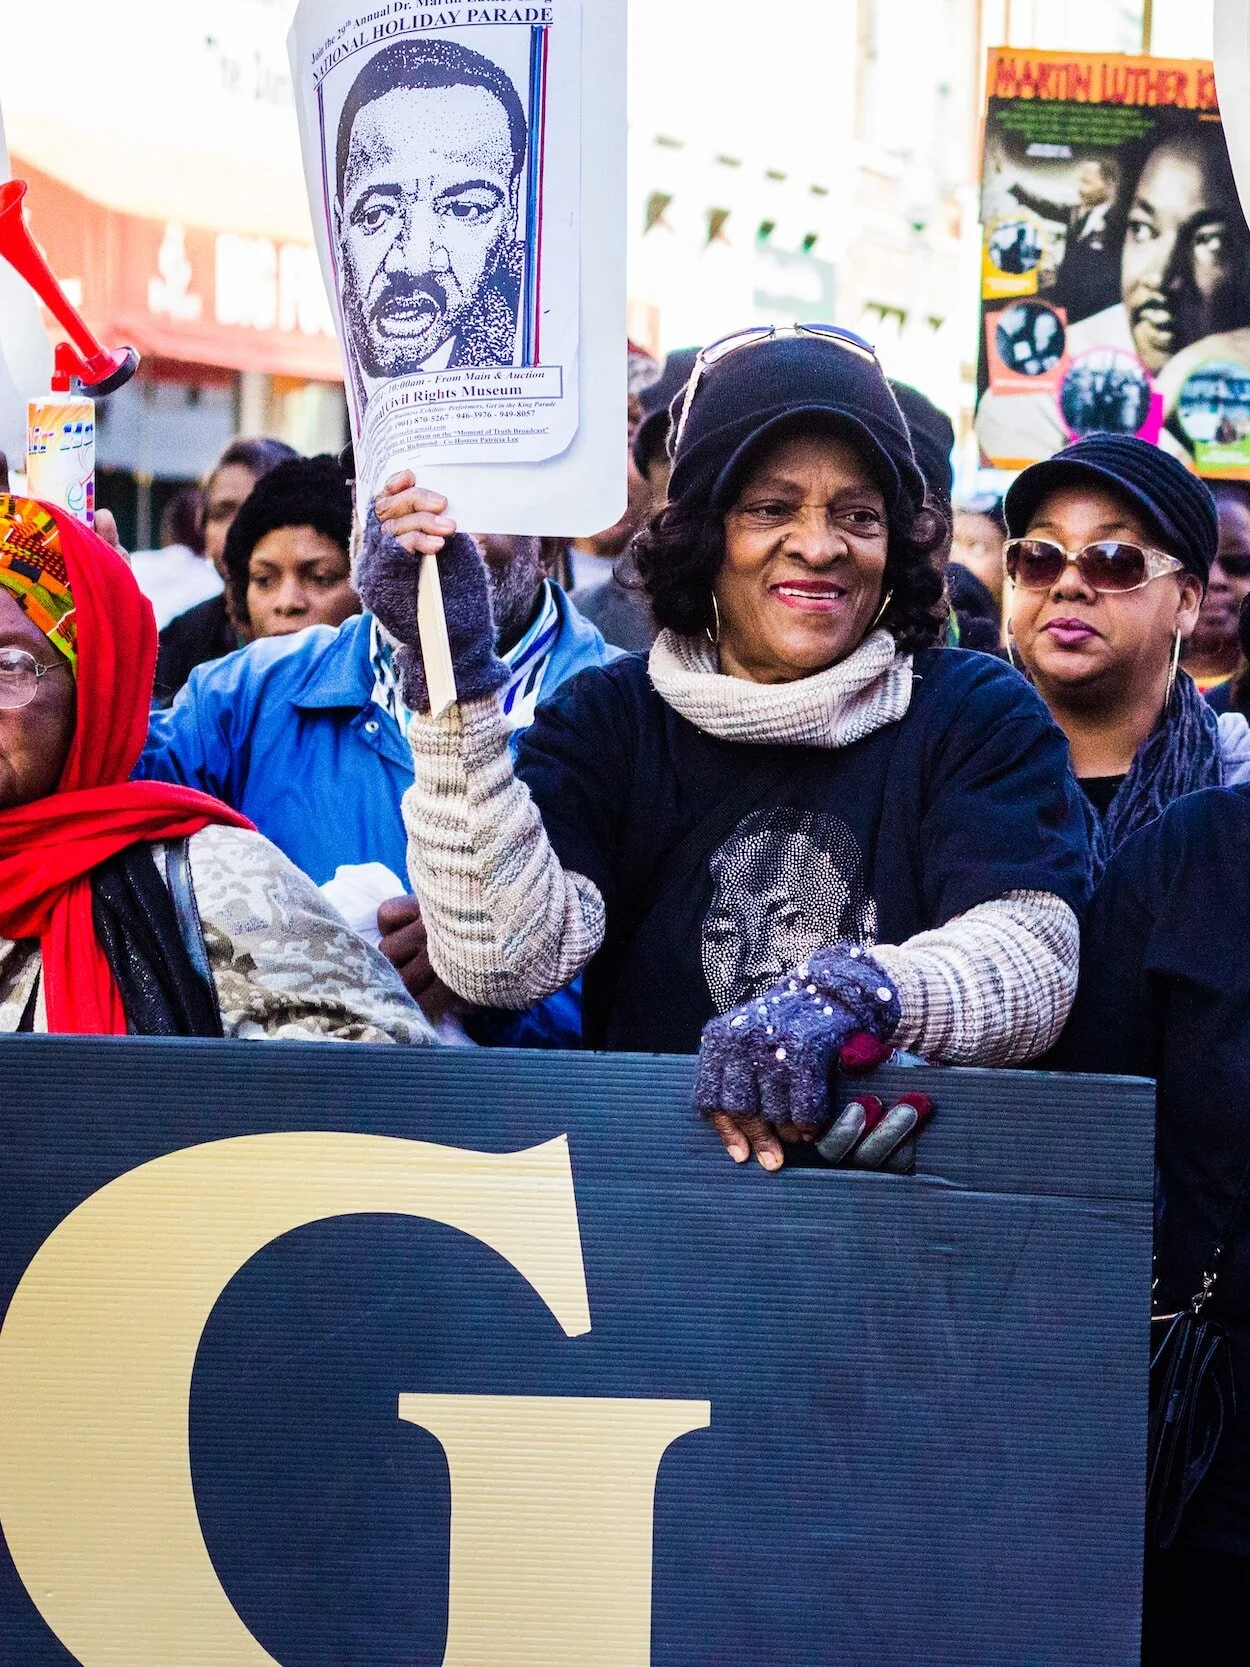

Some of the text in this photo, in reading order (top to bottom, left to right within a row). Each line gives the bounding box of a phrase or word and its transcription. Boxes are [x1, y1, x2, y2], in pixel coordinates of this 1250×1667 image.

[325, 36, 336, 50] the
[353, 4, 390, 30] Annual
[394, 1, 412, 13] Dr.
[312, 32, 369, 87] NATIONAL
[373, 10, 462, 40] HOLIDAY
[467, 7, 553, 23] PARADE
[994, 57, 1092, 102] MARTIN
[1101, 63, 1188, 108] LUTHER
[386, 393, 409, 412] Civil
[414, 388, 457, 404] Rights
[462, 385, 522, 397] Museum
[389, 379, 425, 392] 10:00am
[435, 375, 461, 384] From
[464, 372, 491, 381] Main
[494, 371, 502, 380] &
[506, 370, 545, 379] Auction
[456, 411, 492, 419] 946-3976
[500, 409, 536, 417] 949-8057
[518, 401, 533, 409] King
[0, 1131, 711, 1667] G
